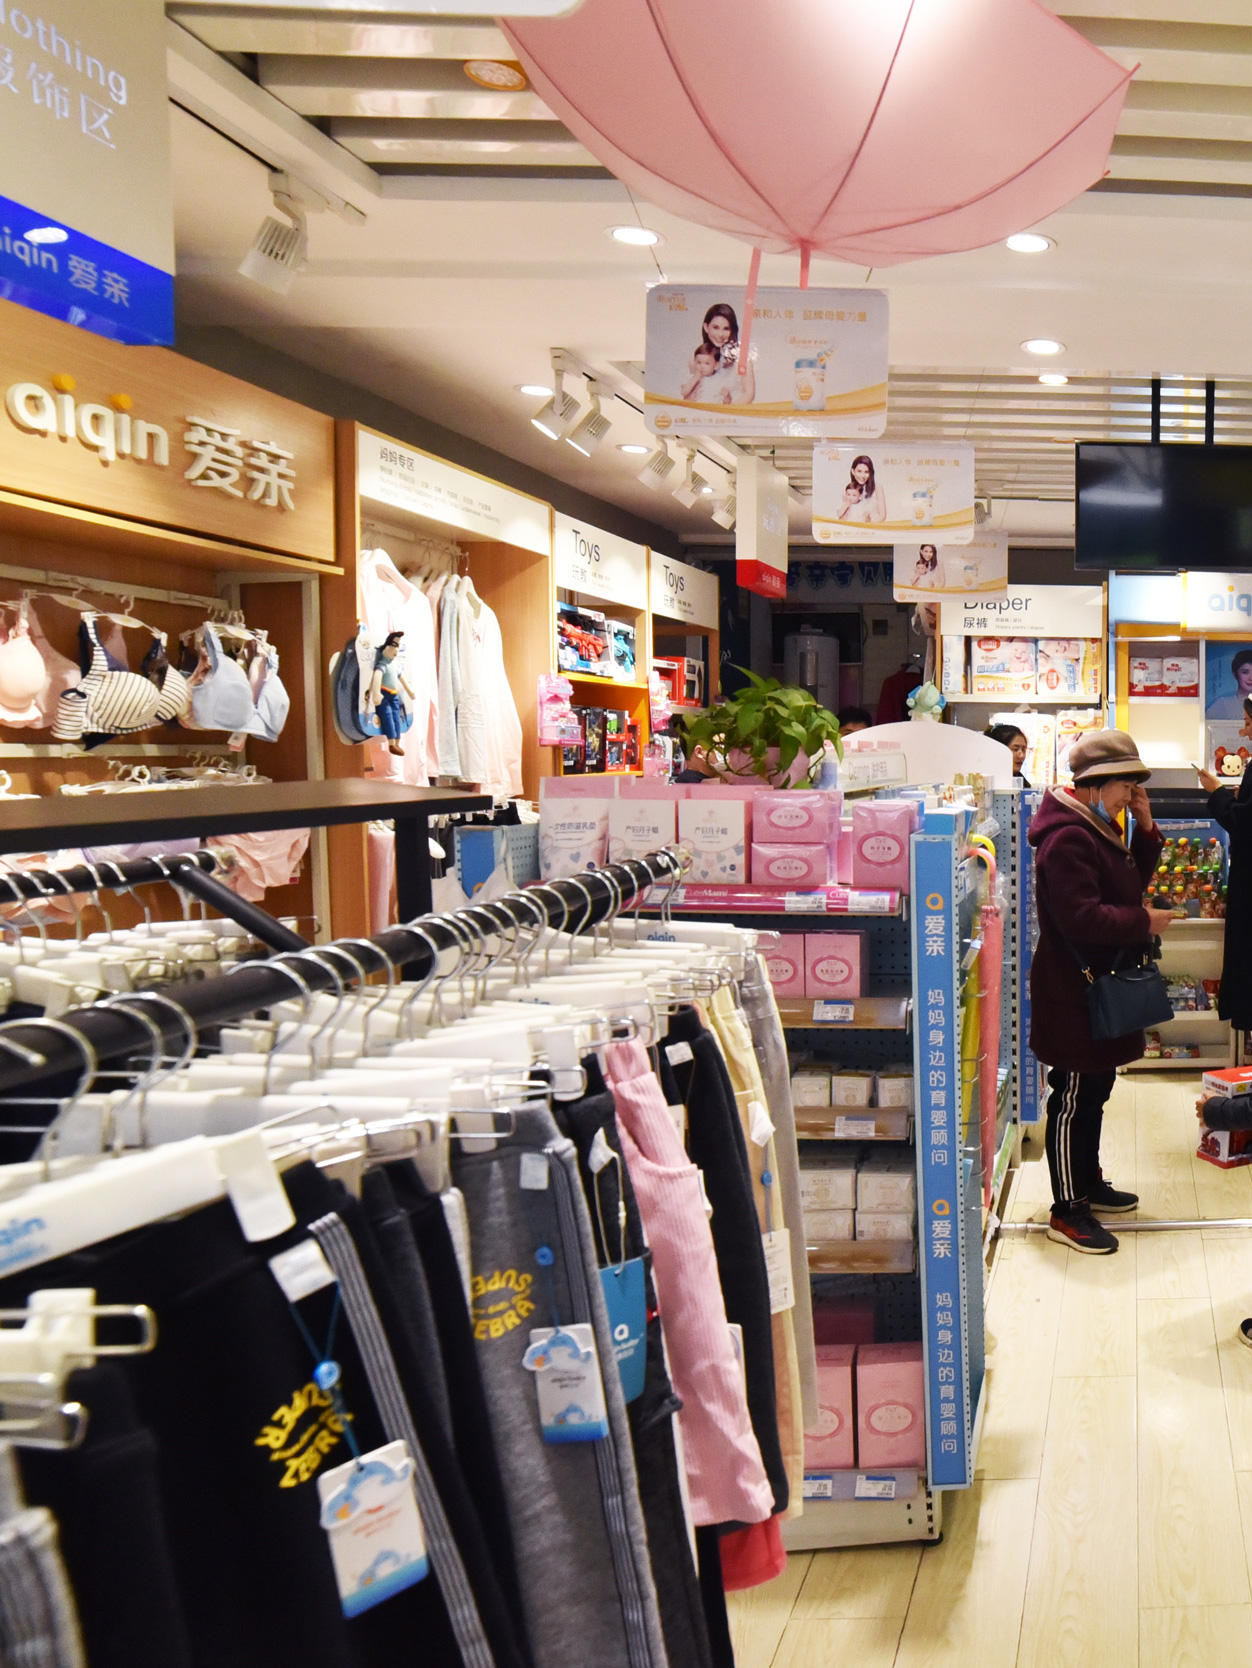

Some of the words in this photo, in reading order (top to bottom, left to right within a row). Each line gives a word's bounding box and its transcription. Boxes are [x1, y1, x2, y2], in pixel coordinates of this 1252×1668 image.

[0, 226, 58, 273] iqin
[67, 254, 130, 308] 爱亲
[6, 374, 170, 466] aiqin
[183, 413, 297, 512] 爱亲
[379, 446, 415, 472] 妈妈专区
[572, 529, 601, 565] Toys
[663, 564, 685, 594] Toys
[963, 616, 988, 629] 尿裤
[924, 915, 946, 957] 爱亲
[927, 988, 949, 1166] 妈妈身边的育婴顾问
[931, 1220, 953, 1259] 爱亲
[474, 1299, 536, 1341] EBRA
[935, 1291, 958, 1455] 妈妈身边的育婴顾问
